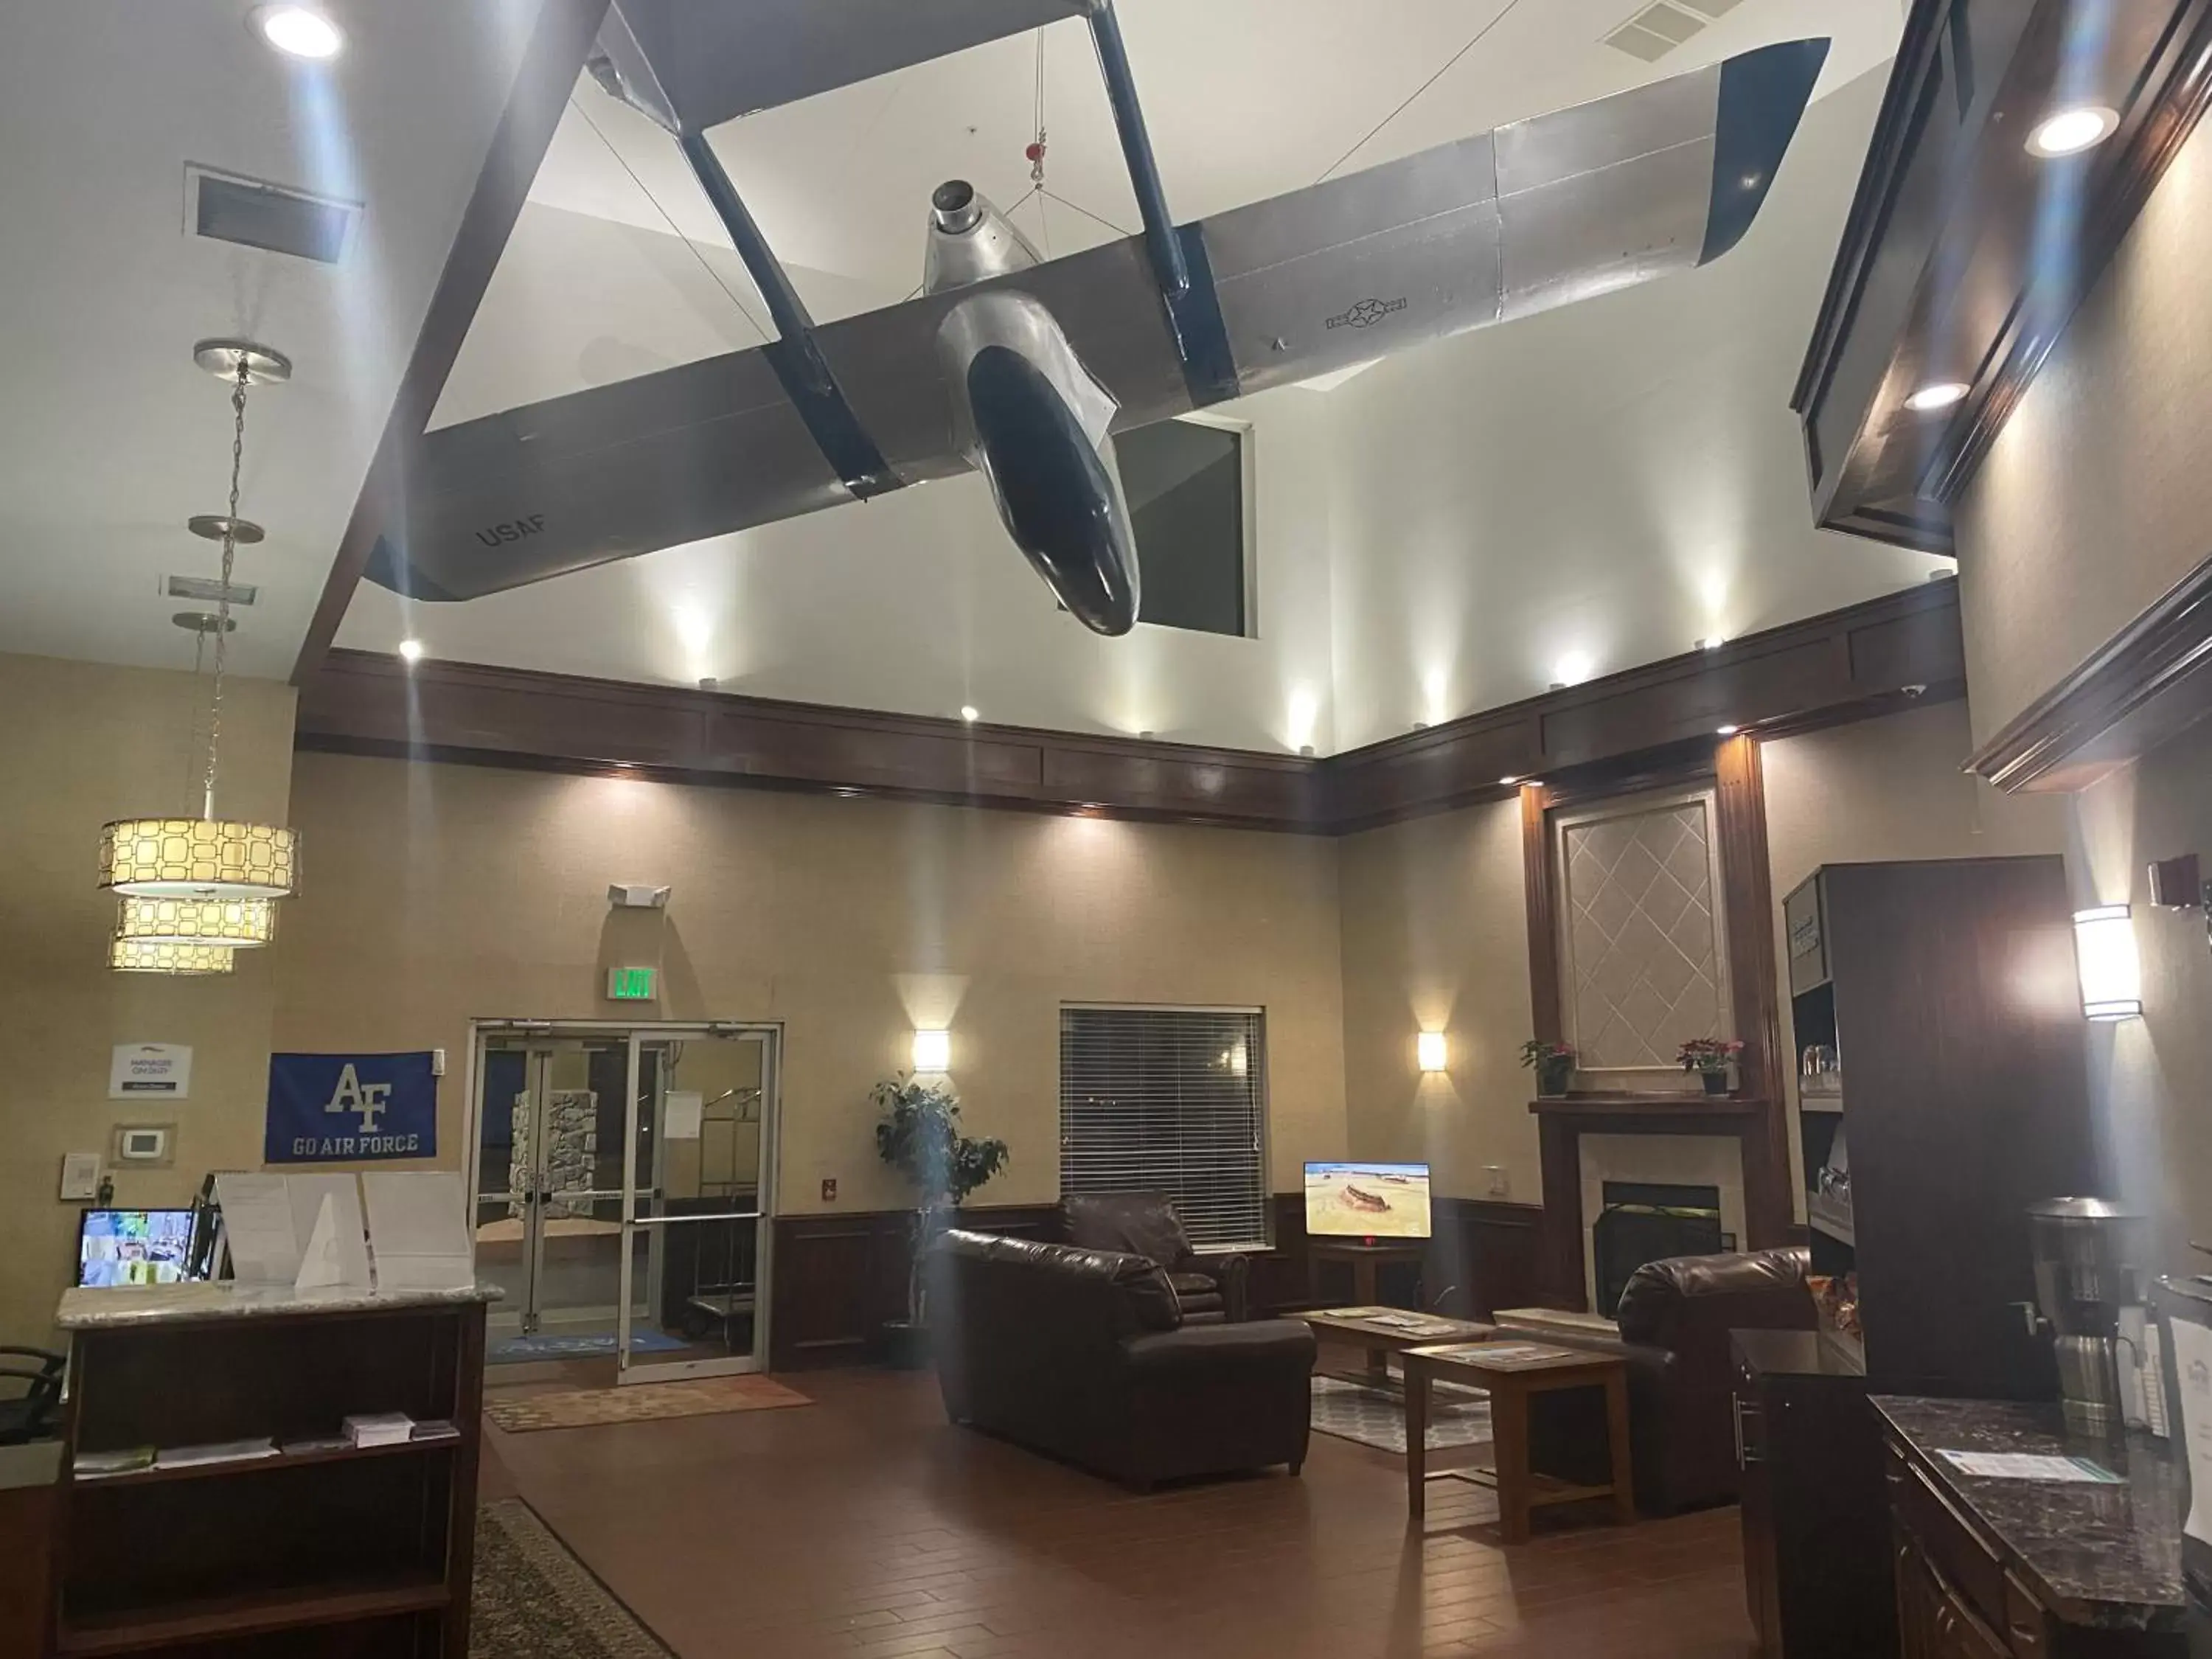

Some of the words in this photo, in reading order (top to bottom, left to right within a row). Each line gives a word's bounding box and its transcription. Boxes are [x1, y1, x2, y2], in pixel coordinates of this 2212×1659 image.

[476, 515, 544, 546] USAF
[324, 1063, 392, 1133] AF
[293, 1138, 316, 1155] GO
[320, 1138, 355, 1155] AIR
[358, 1134, 419, 1154] FORCE
